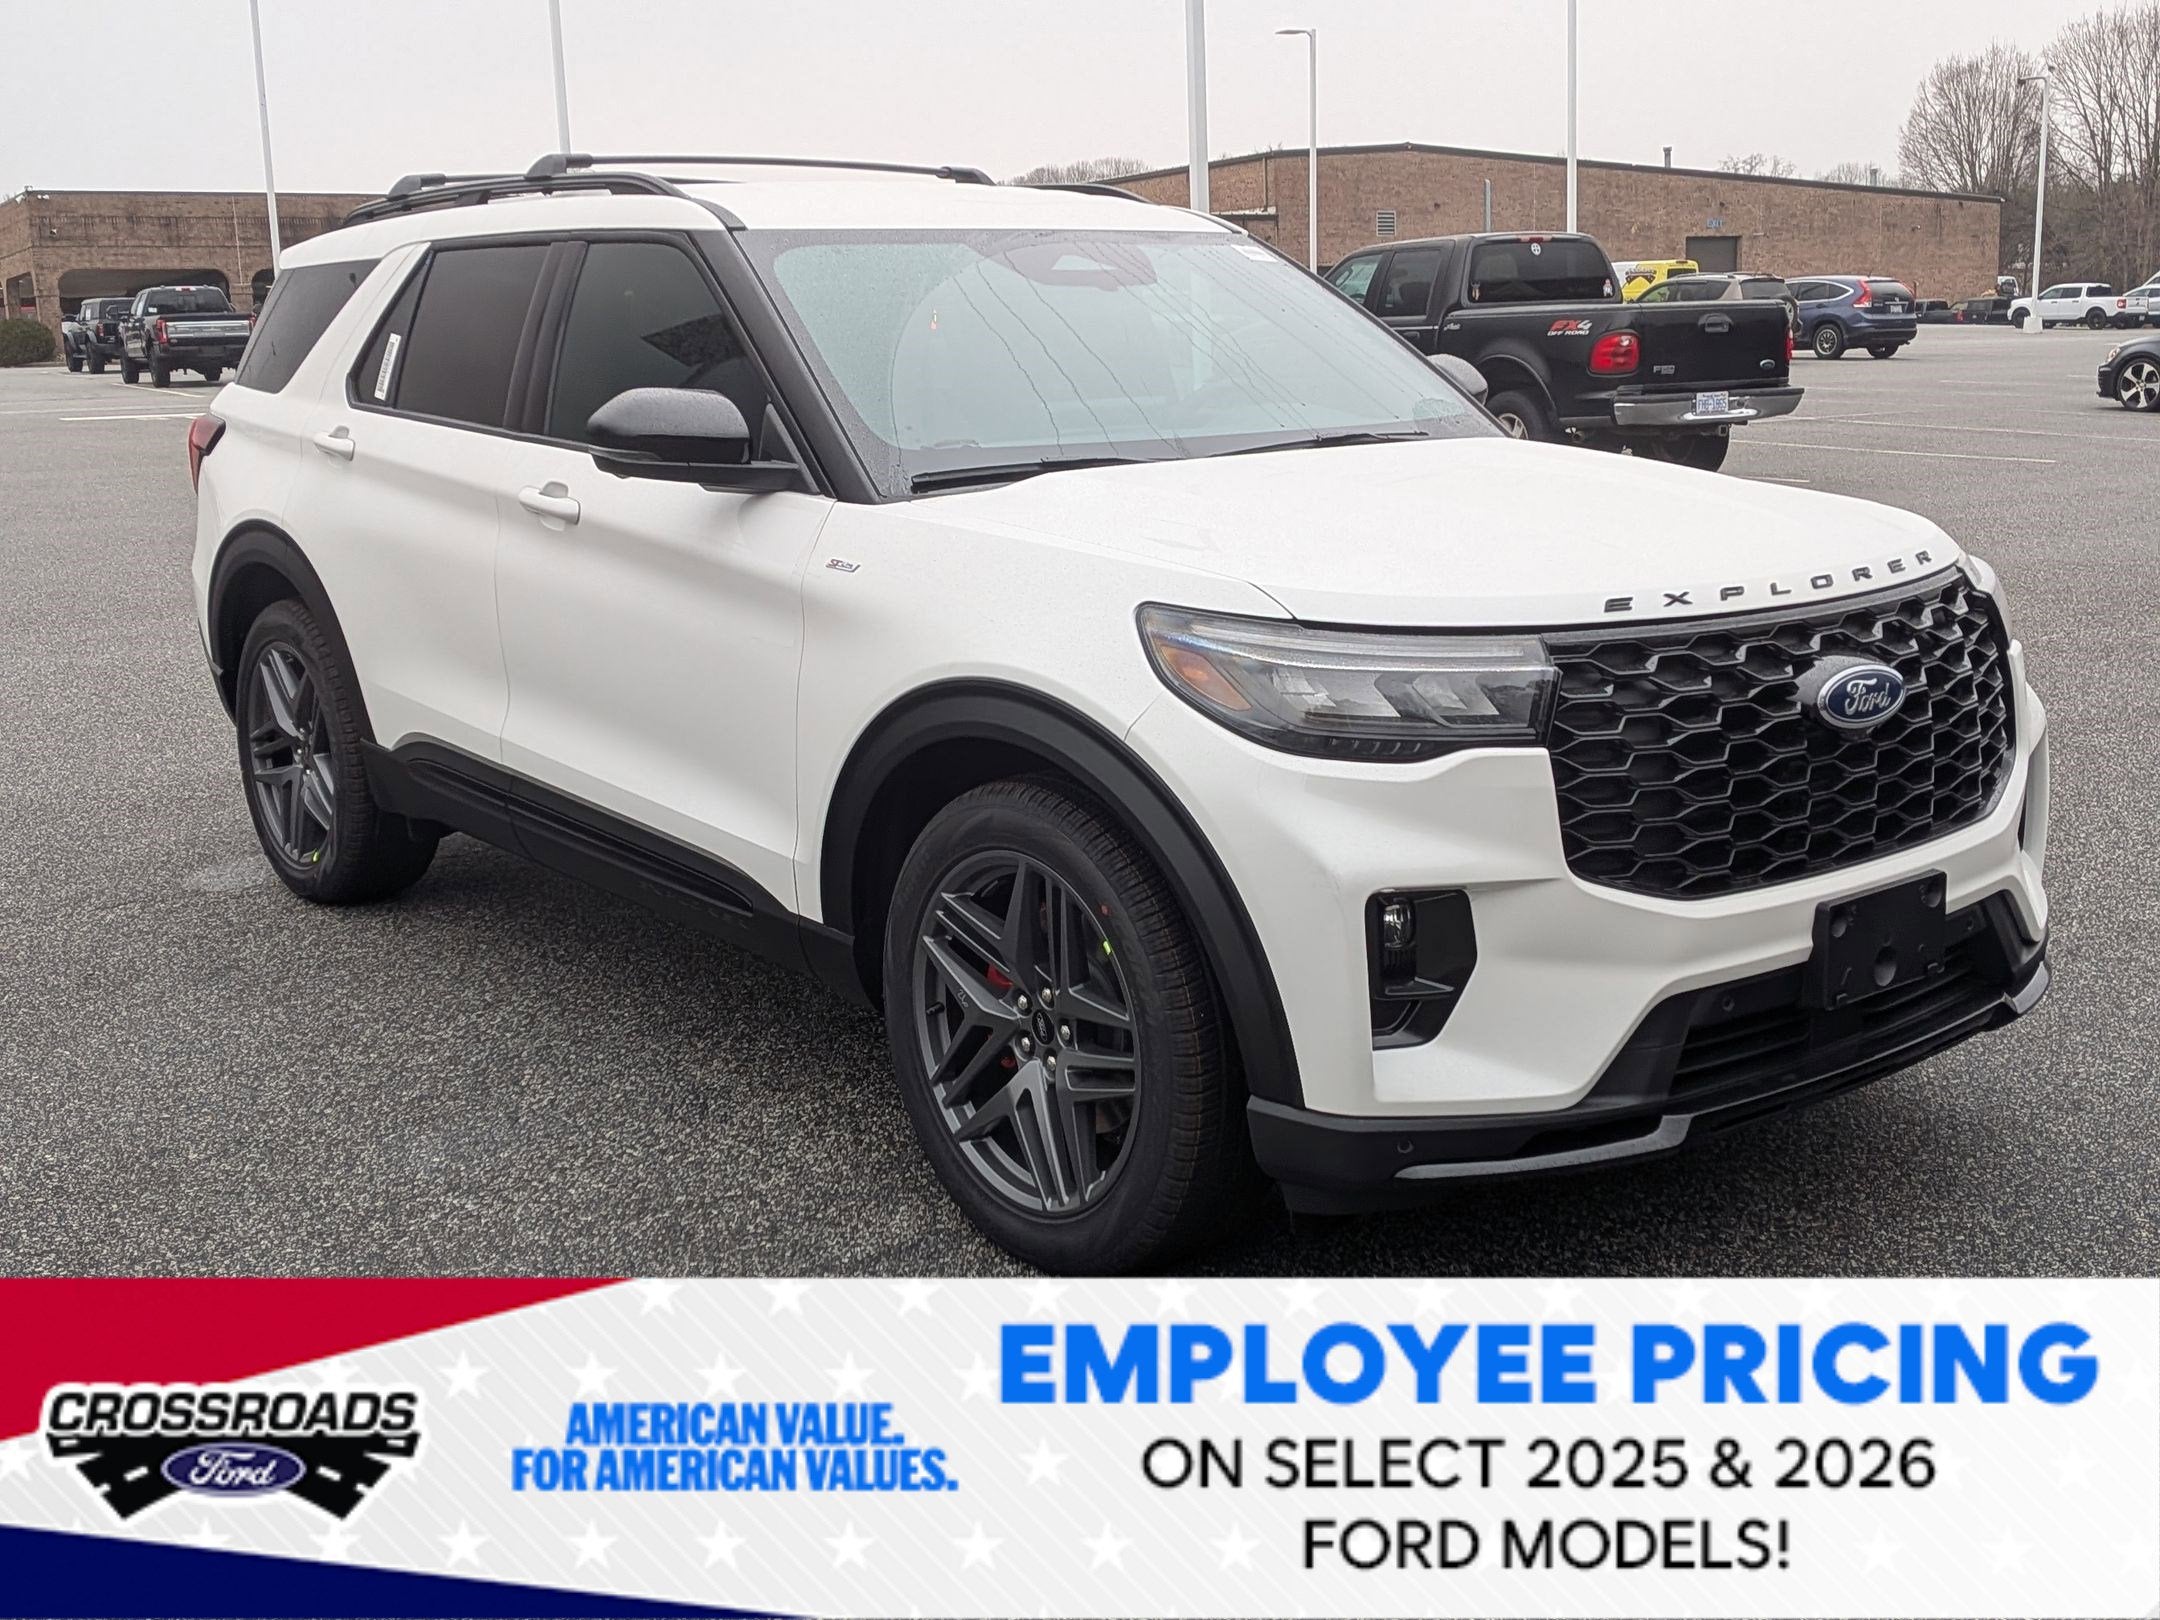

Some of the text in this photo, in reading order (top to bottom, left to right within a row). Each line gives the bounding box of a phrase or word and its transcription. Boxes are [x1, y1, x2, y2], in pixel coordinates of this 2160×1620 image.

[1550, 319, 1593, 331] FX4
[1604, 550, 1932, 613] EXPLORER
[1844, 677, 1892, 716] Ford
